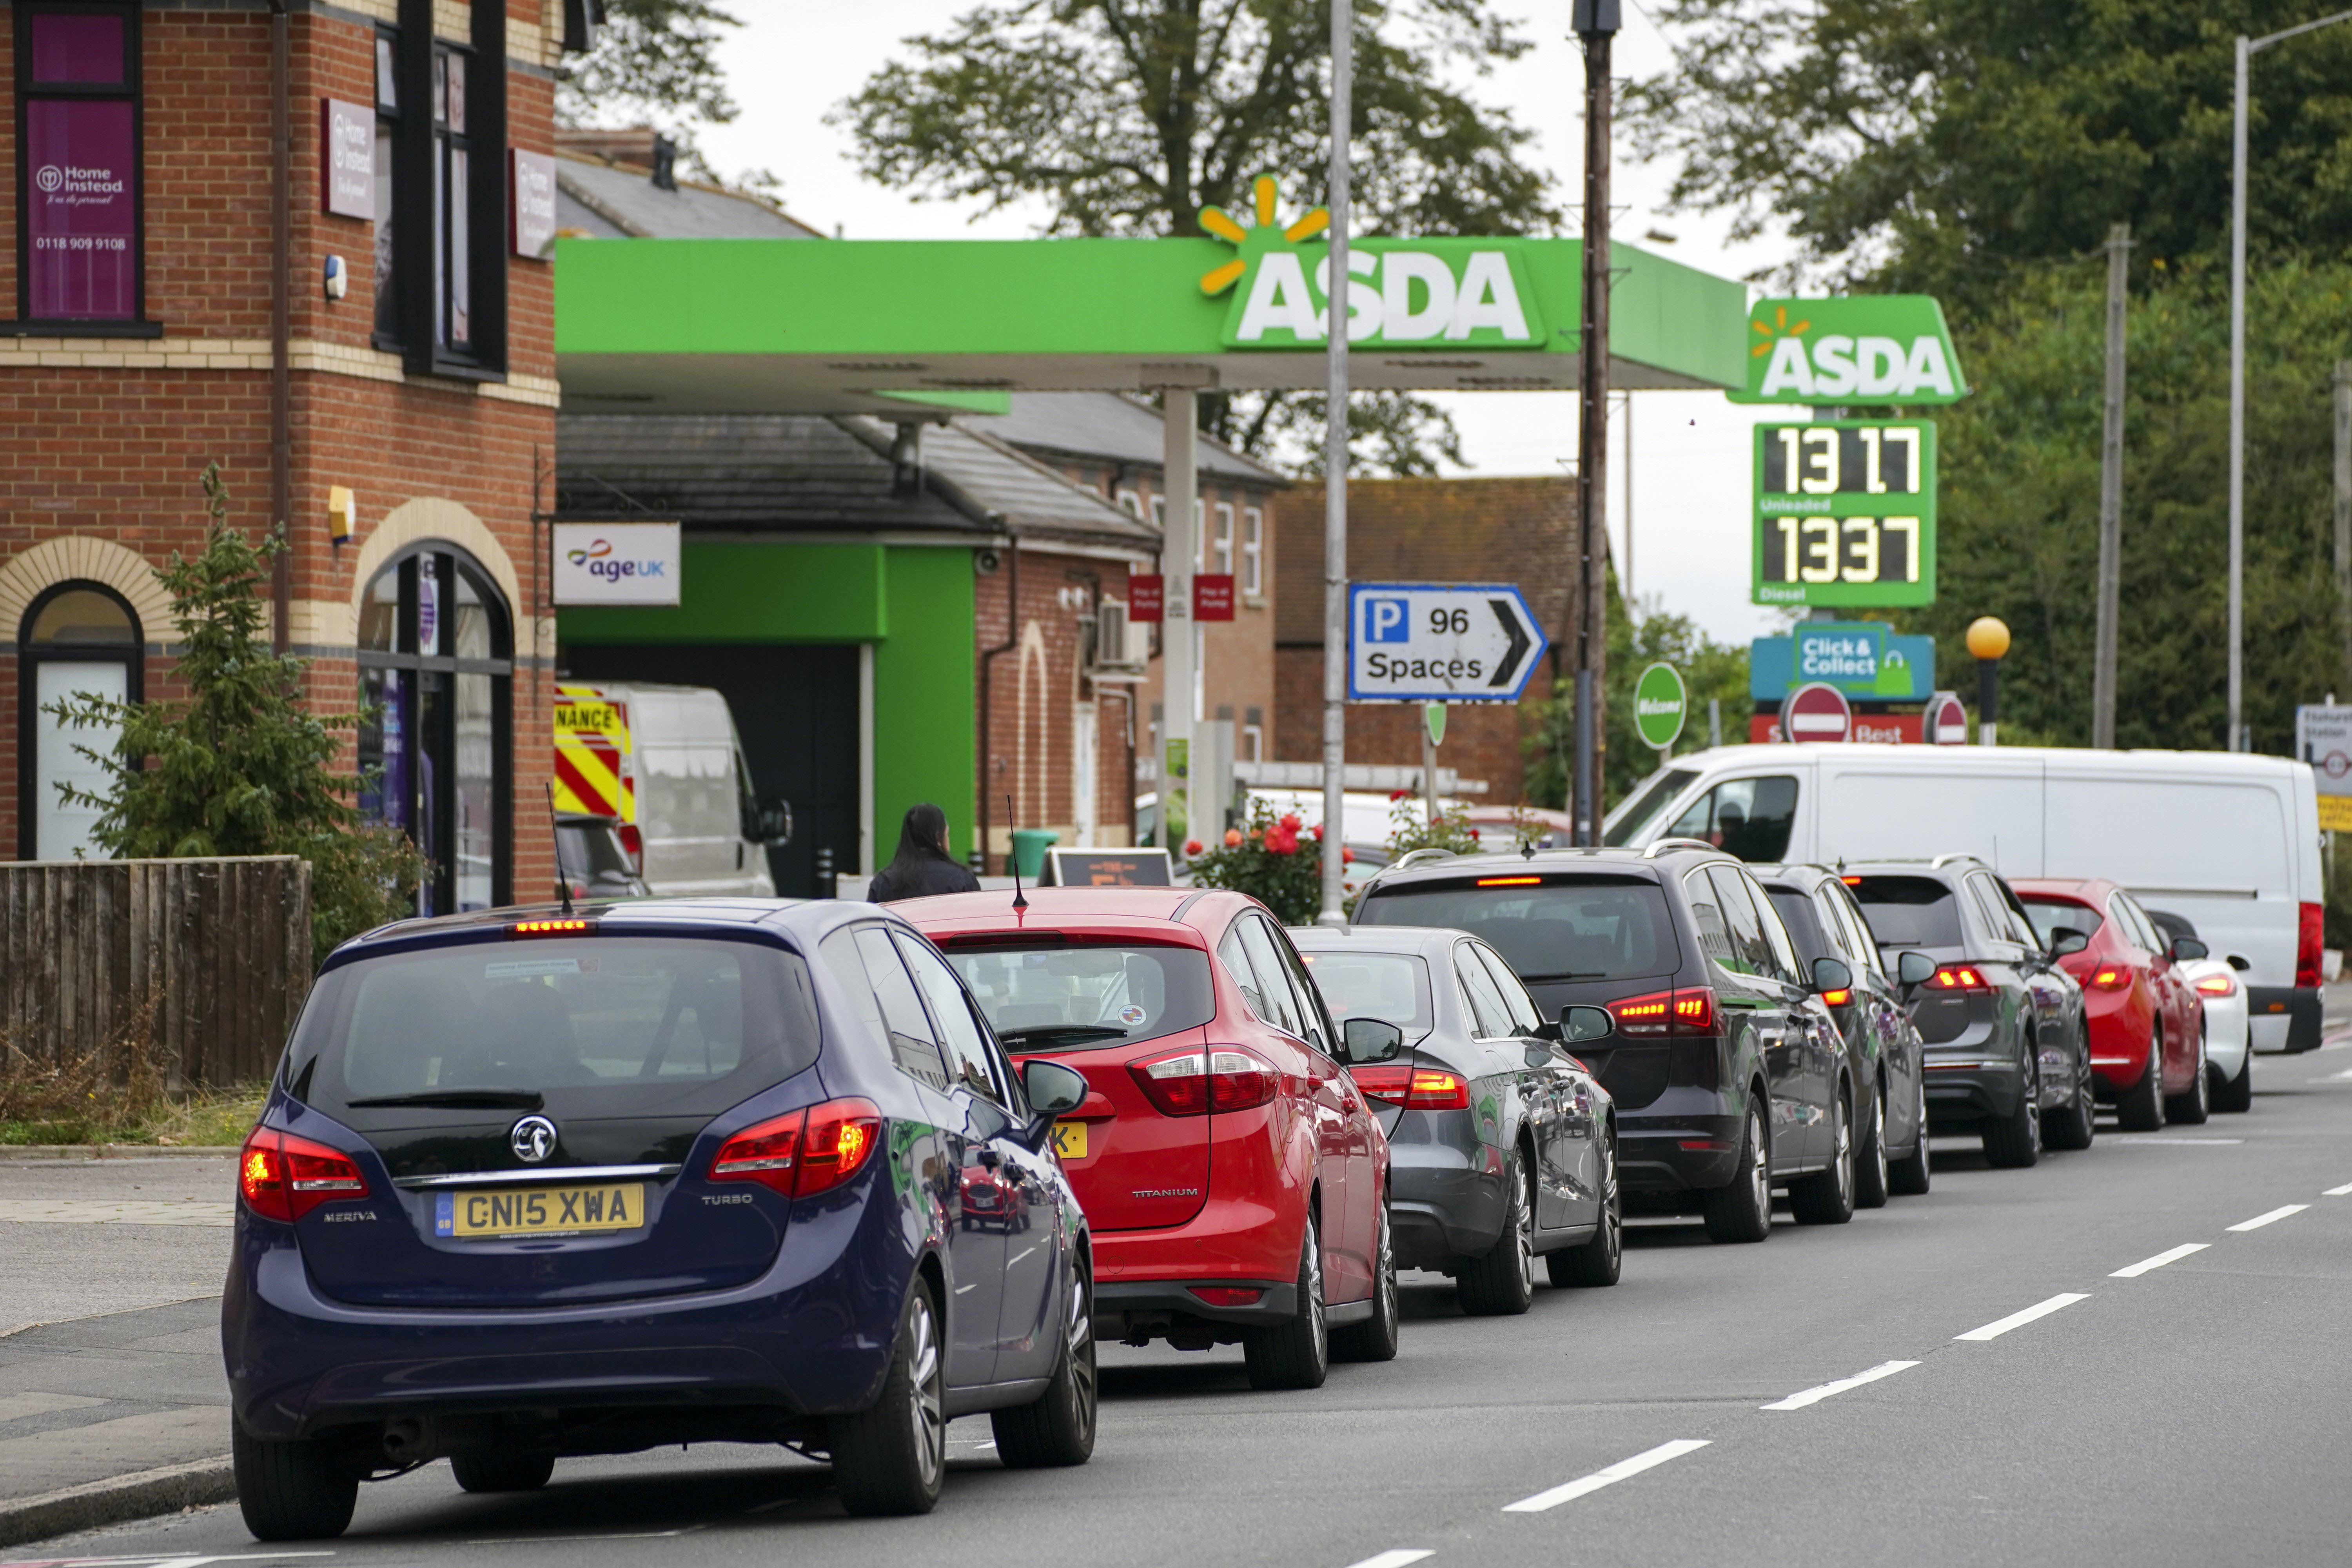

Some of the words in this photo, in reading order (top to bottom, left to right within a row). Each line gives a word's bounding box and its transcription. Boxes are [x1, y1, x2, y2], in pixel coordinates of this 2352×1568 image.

[65, 166, 111, 180] Home
[65, 179, 123, 193] Instead
[36, 237, 67, 250] 0118
[70, 237, 93, 250] 909
[95, 238, 125, 250] 9108
[1236, 249, 1530, 341] ASDA
[1761, 335, 1955, 397] ASDA
[1760, 498, 1831, 512] Unleaded
[590, 561, 634, 583] age
[638, 561, 664, 576] UK
[1760, 587, 1805, 601] Diesel
[1374, 601, 1402, 641] P
[1430, 608, 1469, 634] 96
[1803, 637, 1854, 656] Click
[1856, 638, 1870, 657] &
[1367, 653, 1481, 682] Spaces
[1803, 656, 1876, 675] Collect
[1639, 698, 1681, 715] Welcome
[556, 709, 612, 729] NANCE
[1855, 725, 1902, 743] Best
[702, 1194, 753, 1205] TURBO
[1132, 1189, 1198, 1198] TITANIUM
[324, 1211, 377, 1223] MERIVA
[468, 1194, 546, 1228] CN15
[559, 1190, 627, 1224] XWA
